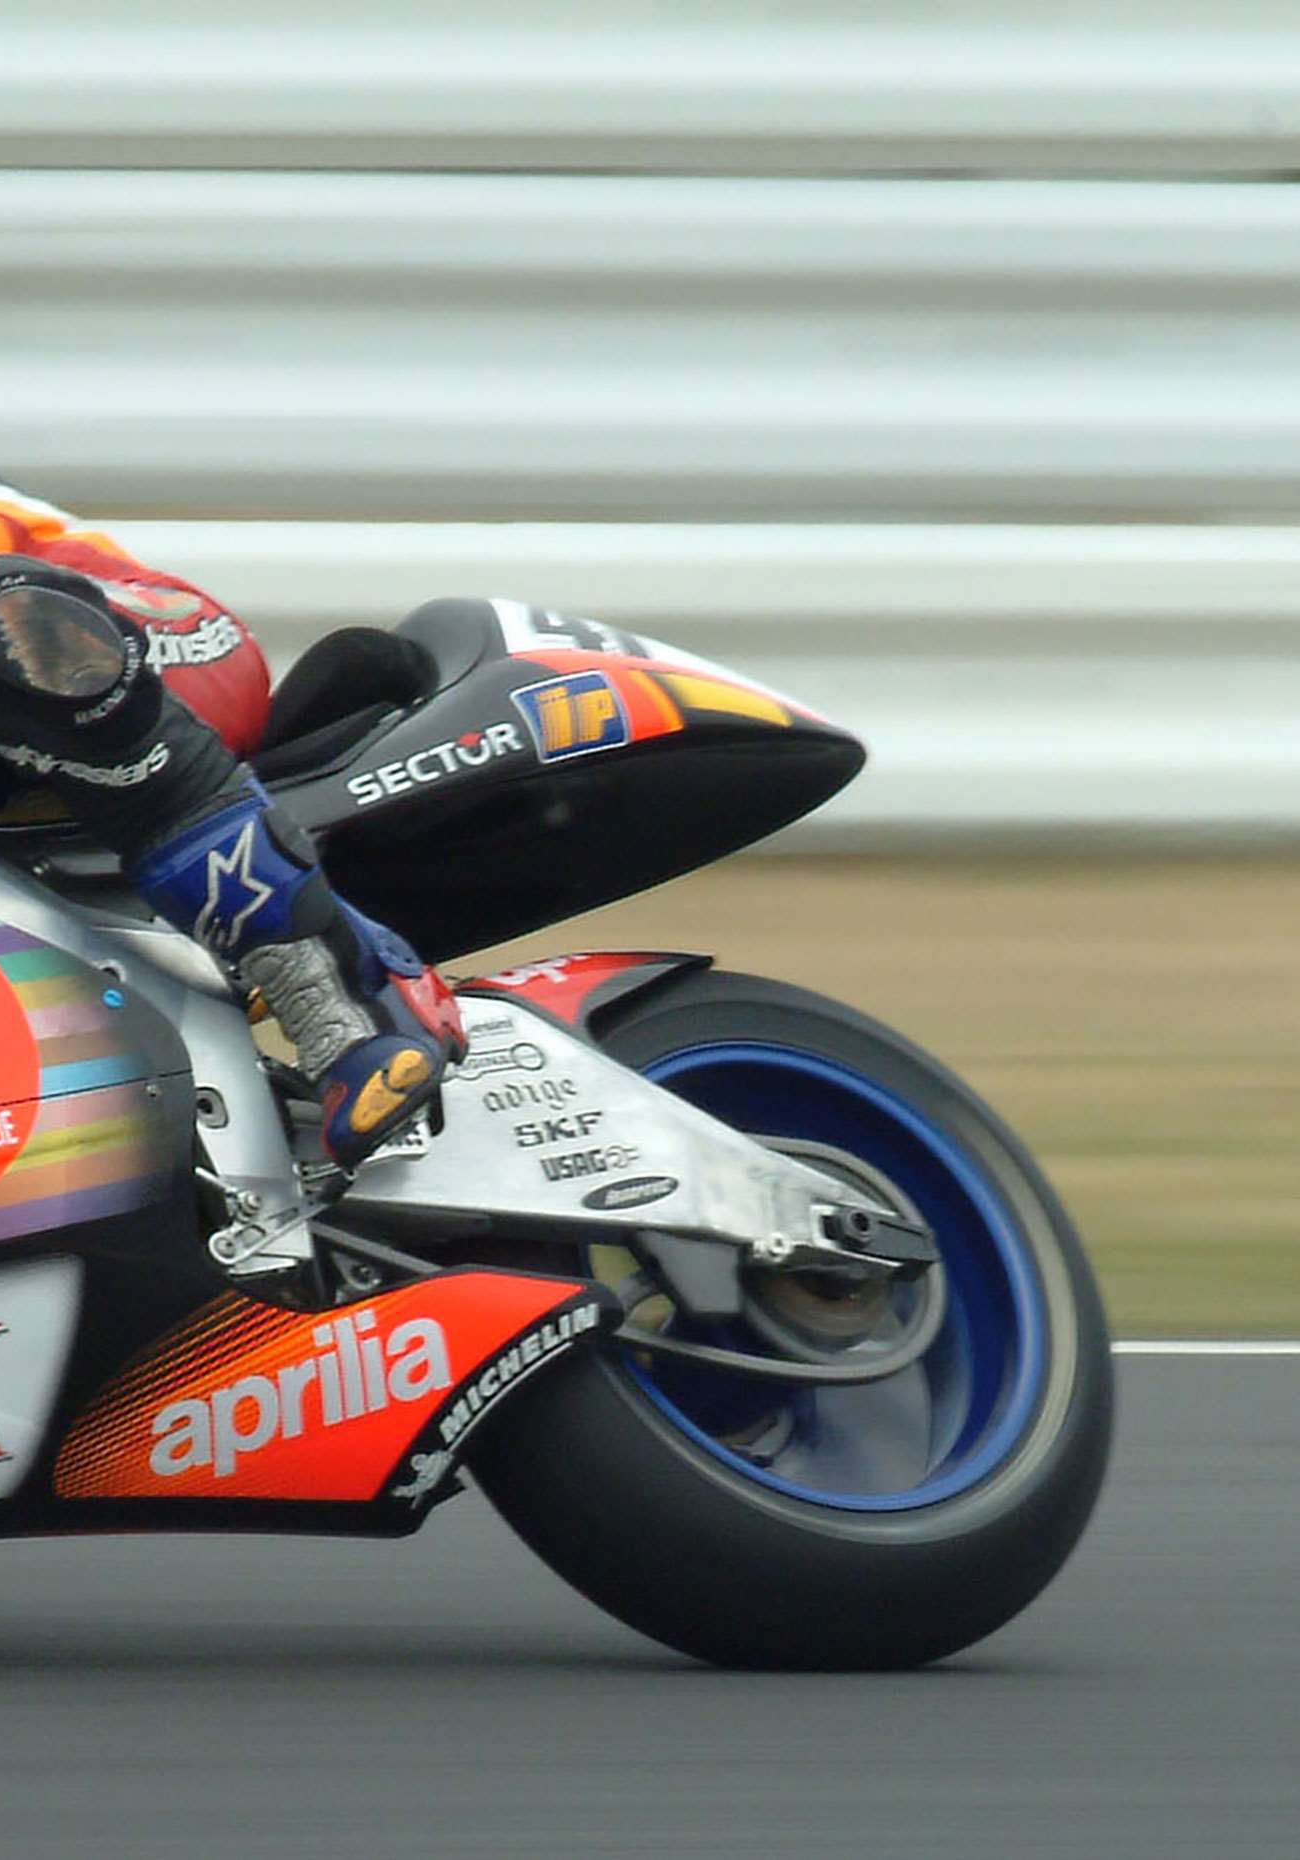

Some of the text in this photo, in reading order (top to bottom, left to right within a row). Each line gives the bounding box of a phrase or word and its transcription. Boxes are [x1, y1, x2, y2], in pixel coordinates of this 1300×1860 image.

[346, 721, 525, 806] SECTOR
[513, 1110, 604, 1148] SKF
[539, 1148, 609, 1182] USAG
[148, 1307, 454, 1478] aprilia
[438, 1302, 600, 1445] MICHELIN
